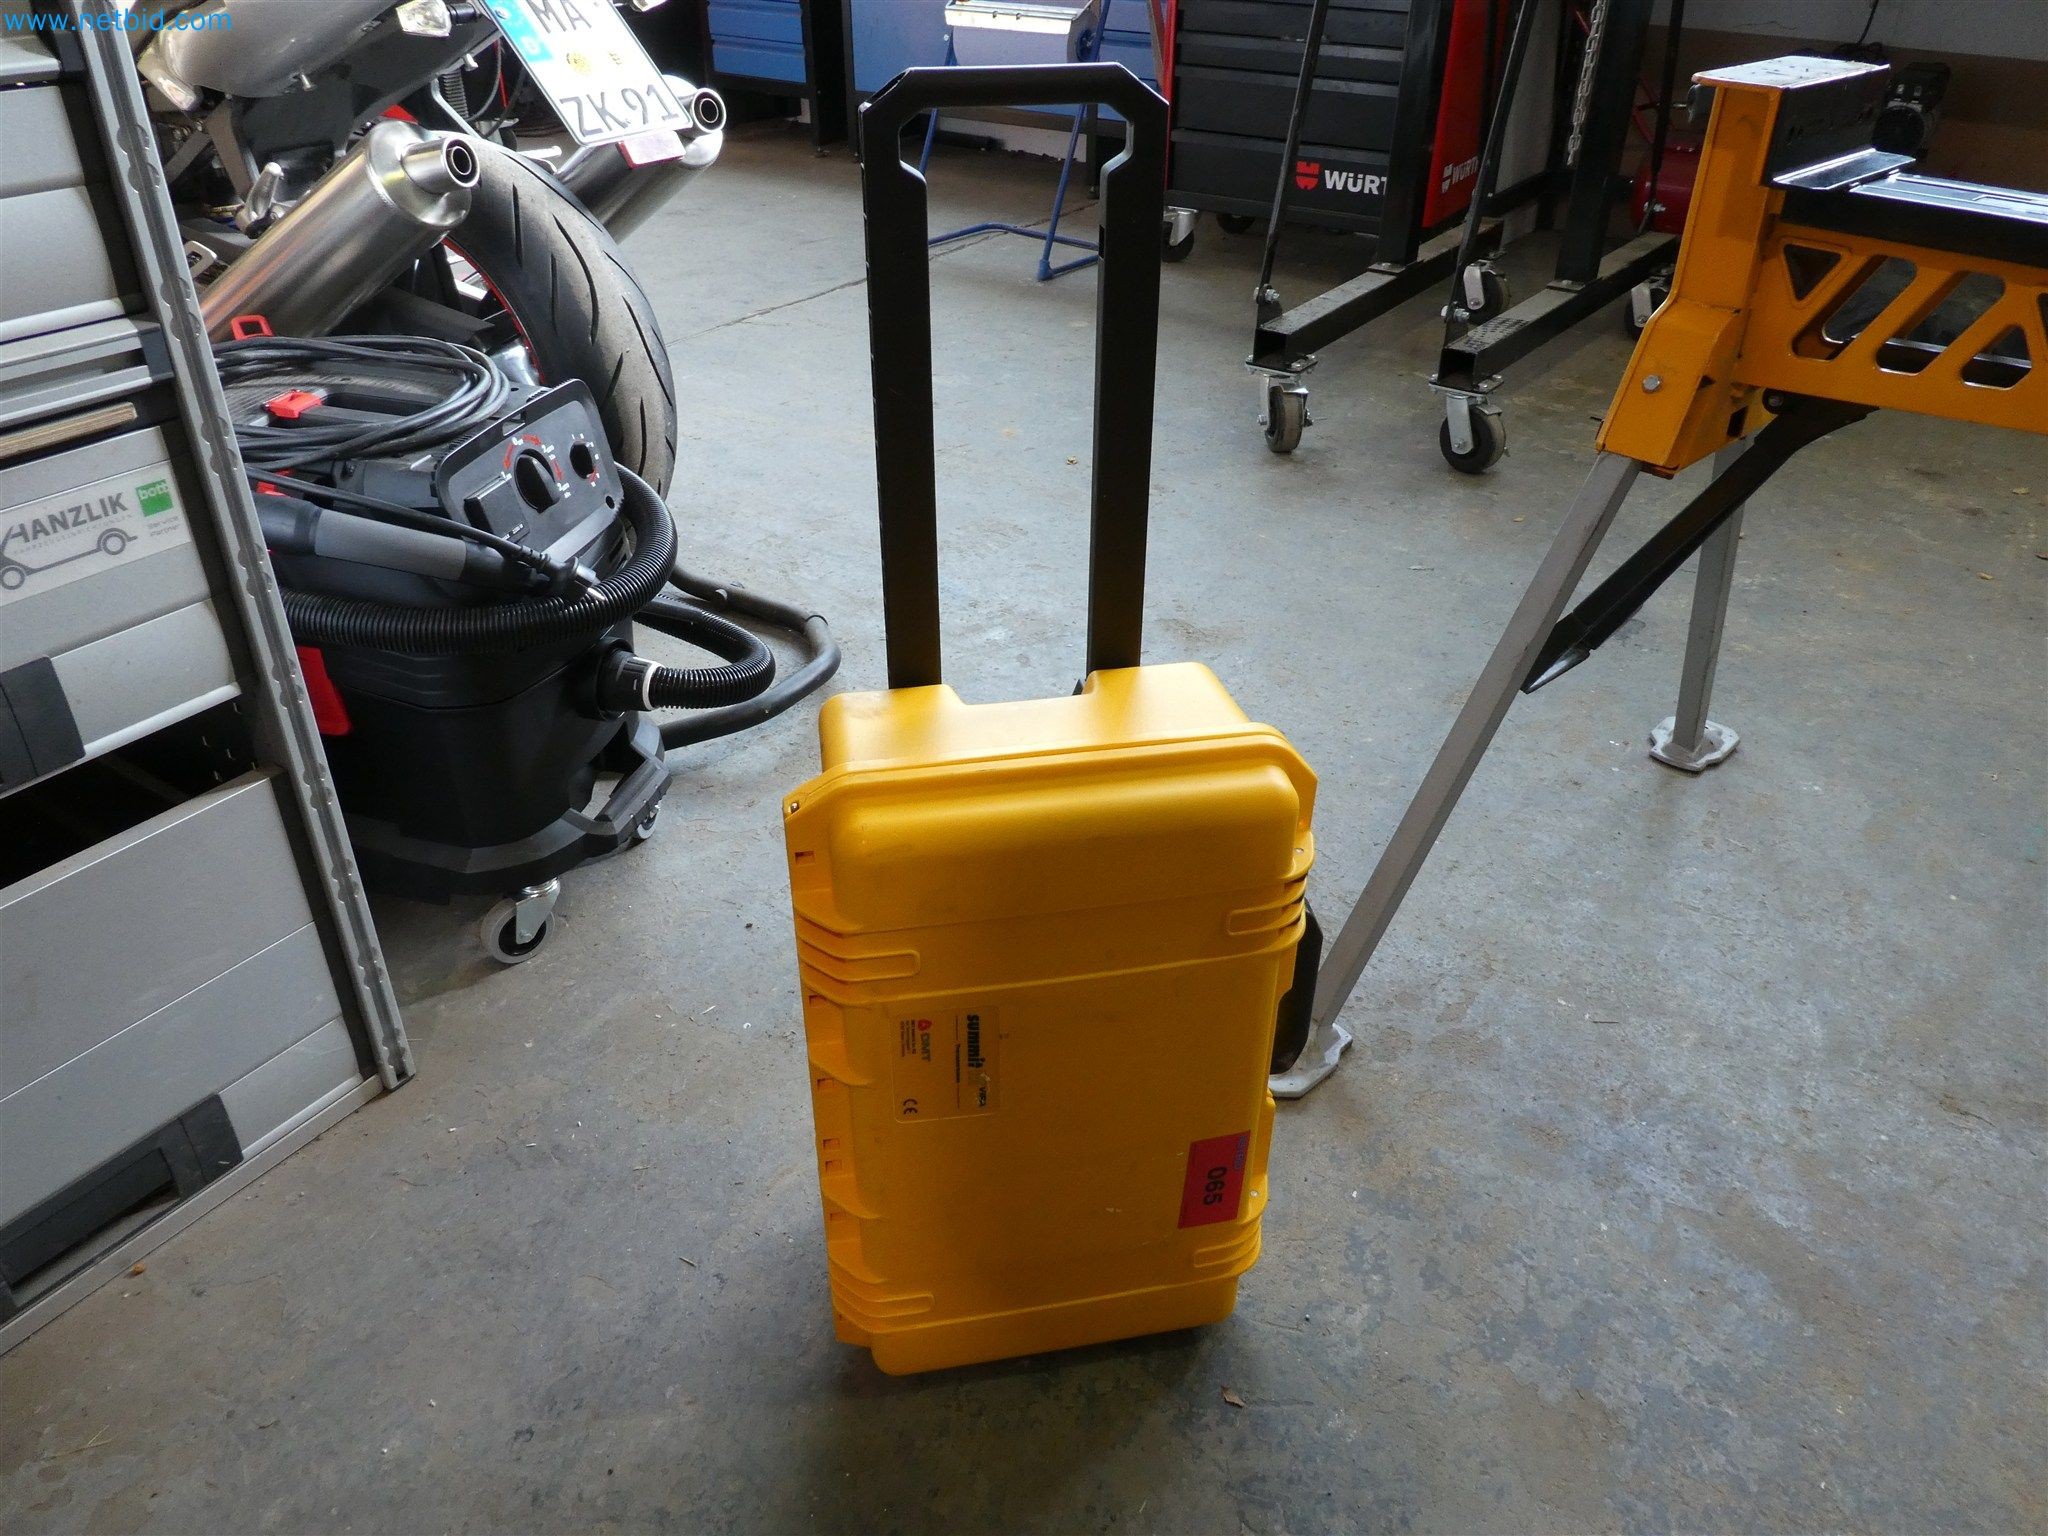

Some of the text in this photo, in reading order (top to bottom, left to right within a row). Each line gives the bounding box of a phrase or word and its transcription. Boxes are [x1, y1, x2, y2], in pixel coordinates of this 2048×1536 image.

[5, 492, 128, 547] HANZLIK
[966, 1014, 986, 1068] summit
[1203, 1166, 1228, 1206] 065
